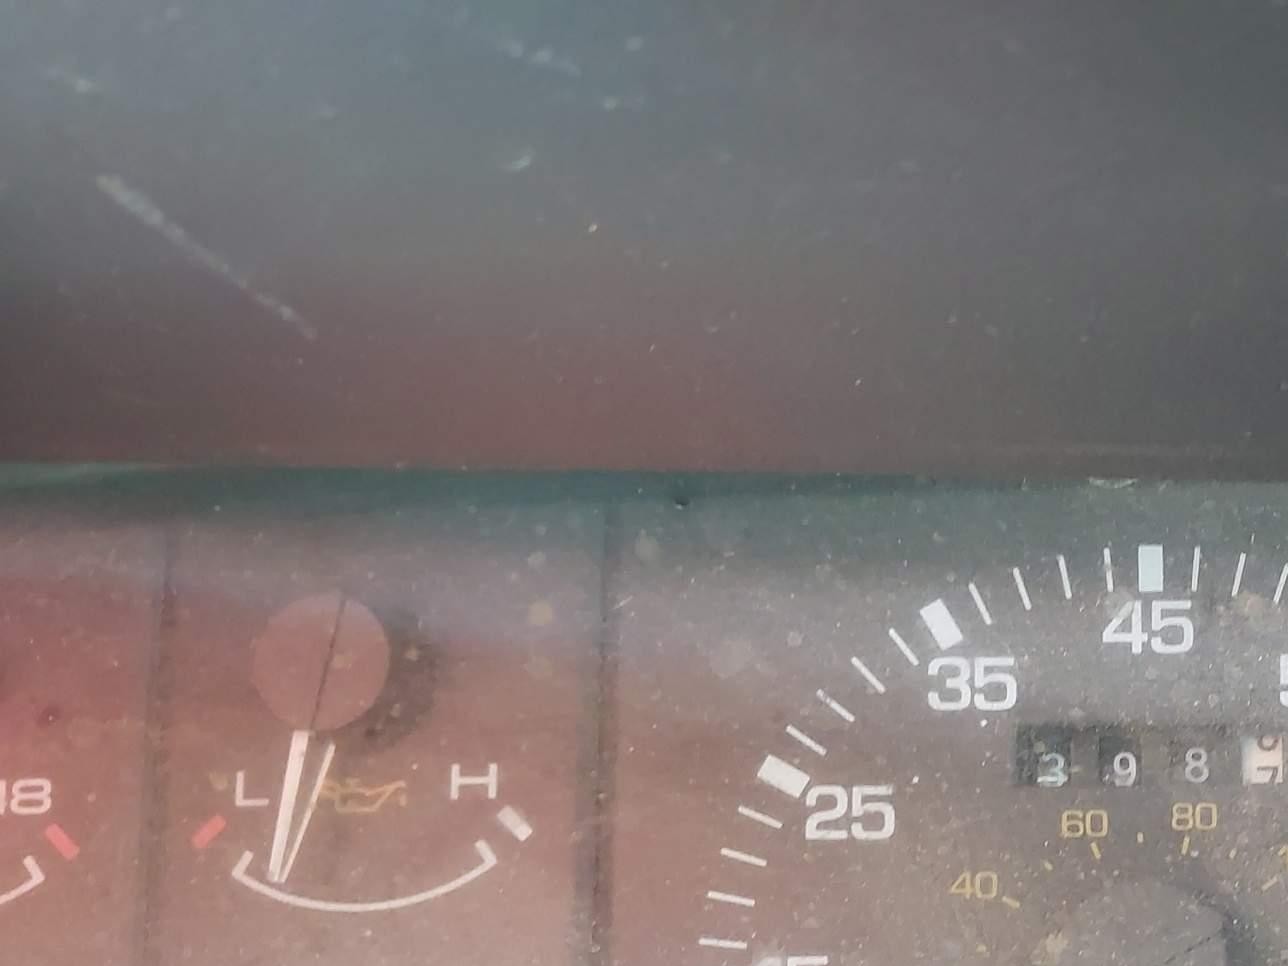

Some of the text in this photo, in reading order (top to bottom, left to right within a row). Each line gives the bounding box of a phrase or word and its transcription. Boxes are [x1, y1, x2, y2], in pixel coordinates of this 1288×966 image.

[1102, 600, 1195, 654] 45
[926, 656, 1018, 711] 35
[235, 771, 270, 808] L
[450, 763, 498, 800] H
[804, 785, 896, 841] 25
[1060, 809, 1109, 838] 60
[1170, 803, 1218, 831] 80
[949, 872, 998, 900] 40
